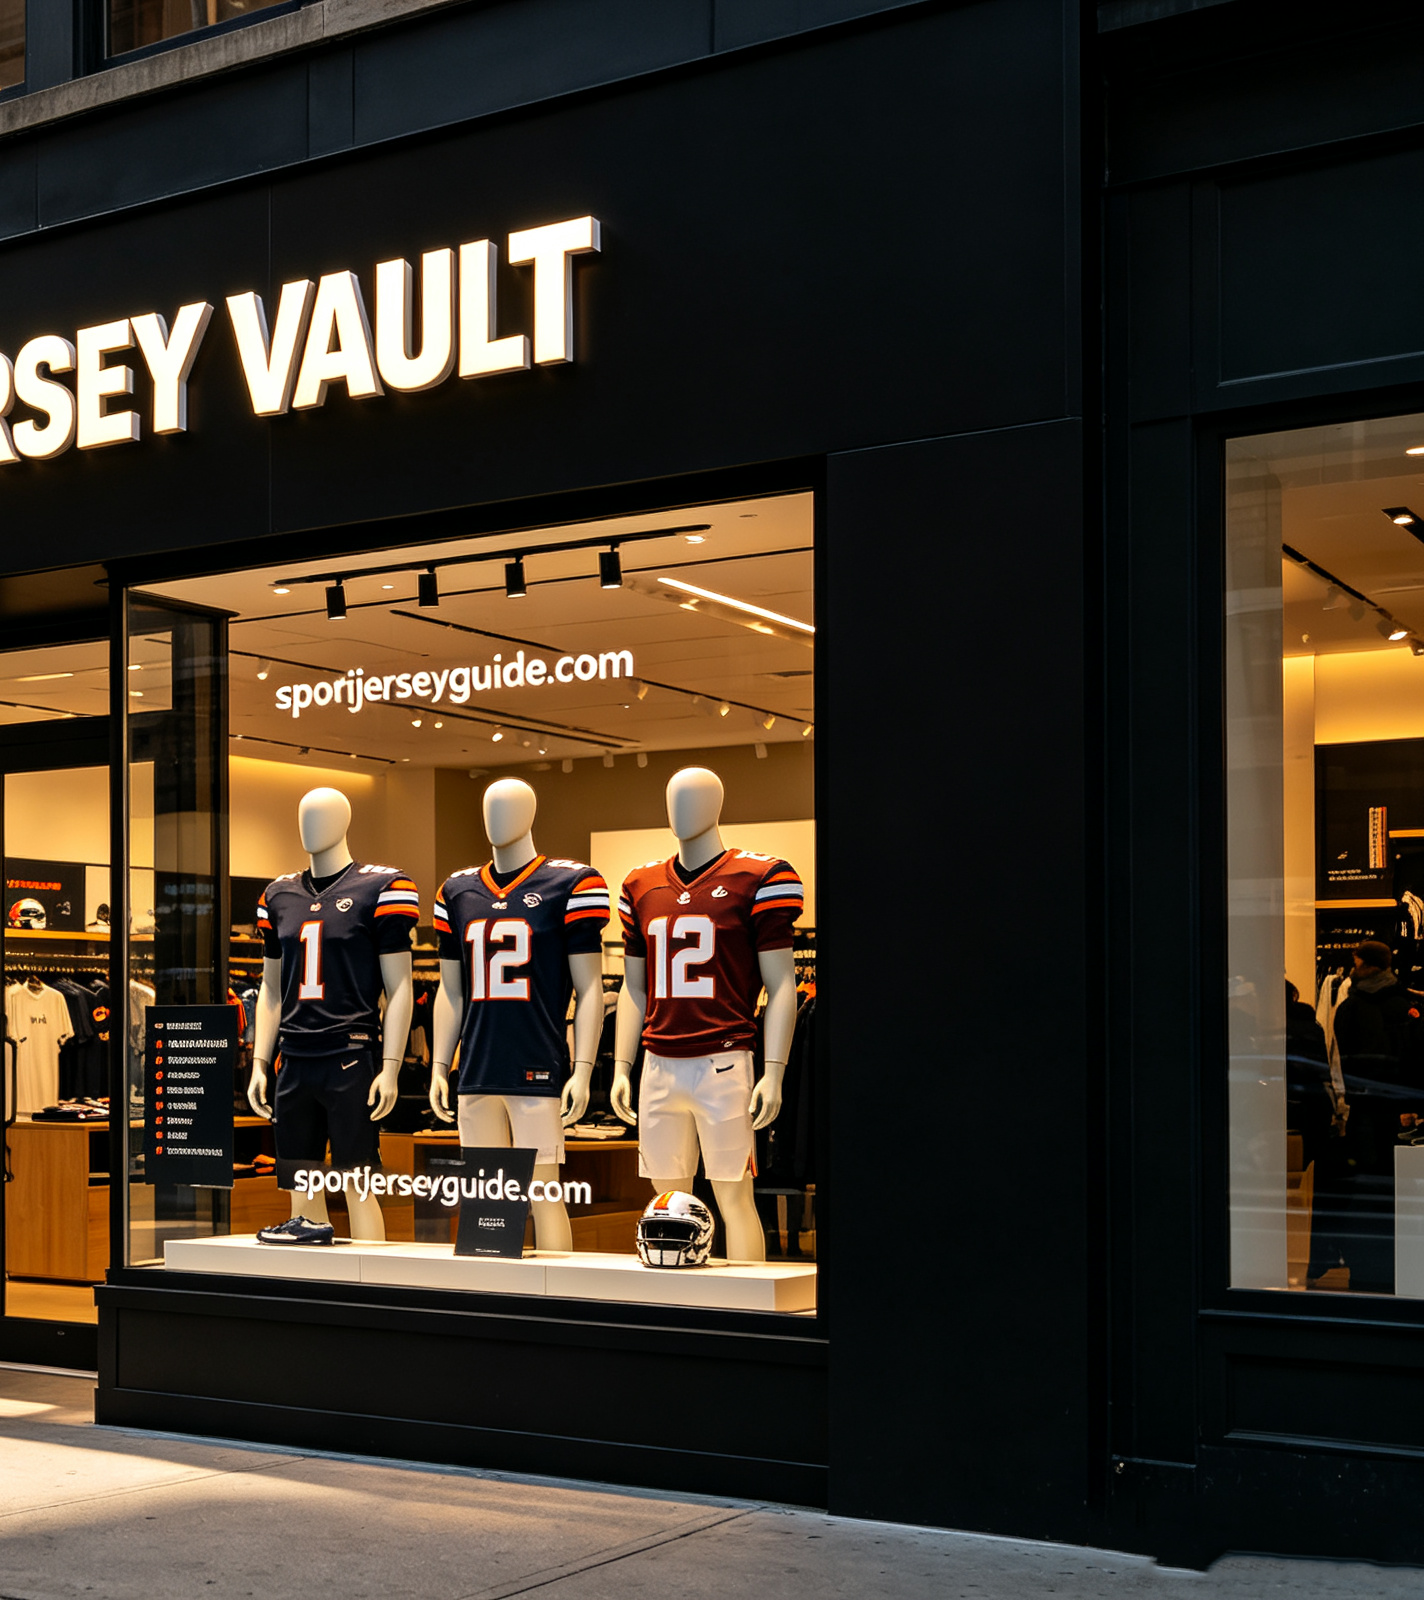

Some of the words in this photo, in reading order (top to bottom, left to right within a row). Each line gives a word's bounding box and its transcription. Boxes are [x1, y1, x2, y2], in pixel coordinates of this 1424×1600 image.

[226, 216, 601, 416] VAULT
[298, 920, 325, 1001] 1
[465, 918, 533, 1002] 12
[647, 914, 716, 999] 12
